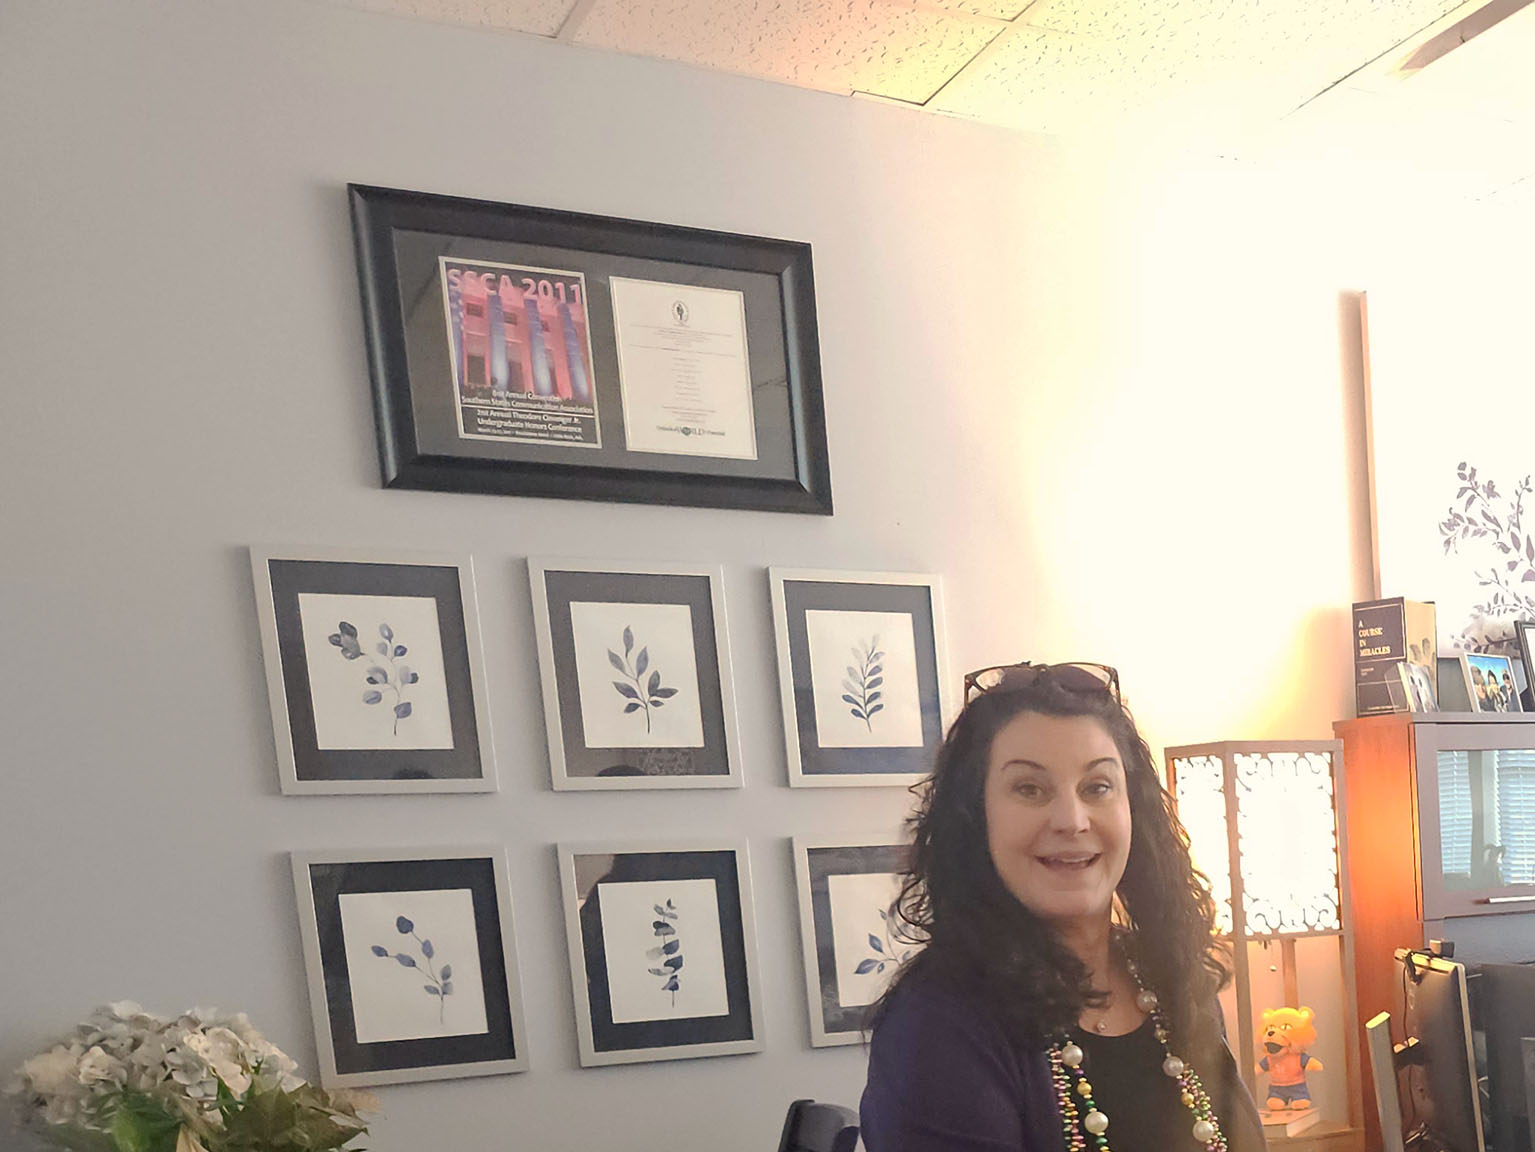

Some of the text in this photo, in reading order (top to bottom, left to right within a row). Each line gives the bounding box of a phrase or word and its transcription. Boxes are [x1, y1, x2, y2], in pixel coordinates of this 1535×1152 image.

[447, 268, 581, 305] SSCA 2011
[477, 417, 524, 429] Undergraduate
[525, 420, 548, 430] Honors
[548, 422, 583, 434] Conference
[1358, 620, 1364, 628] A
[1358, 627, 1383, 638] COURSE
[1359, 638, 1367, 648] IN
[1359, 645, 1391, 657] MIRACLES
